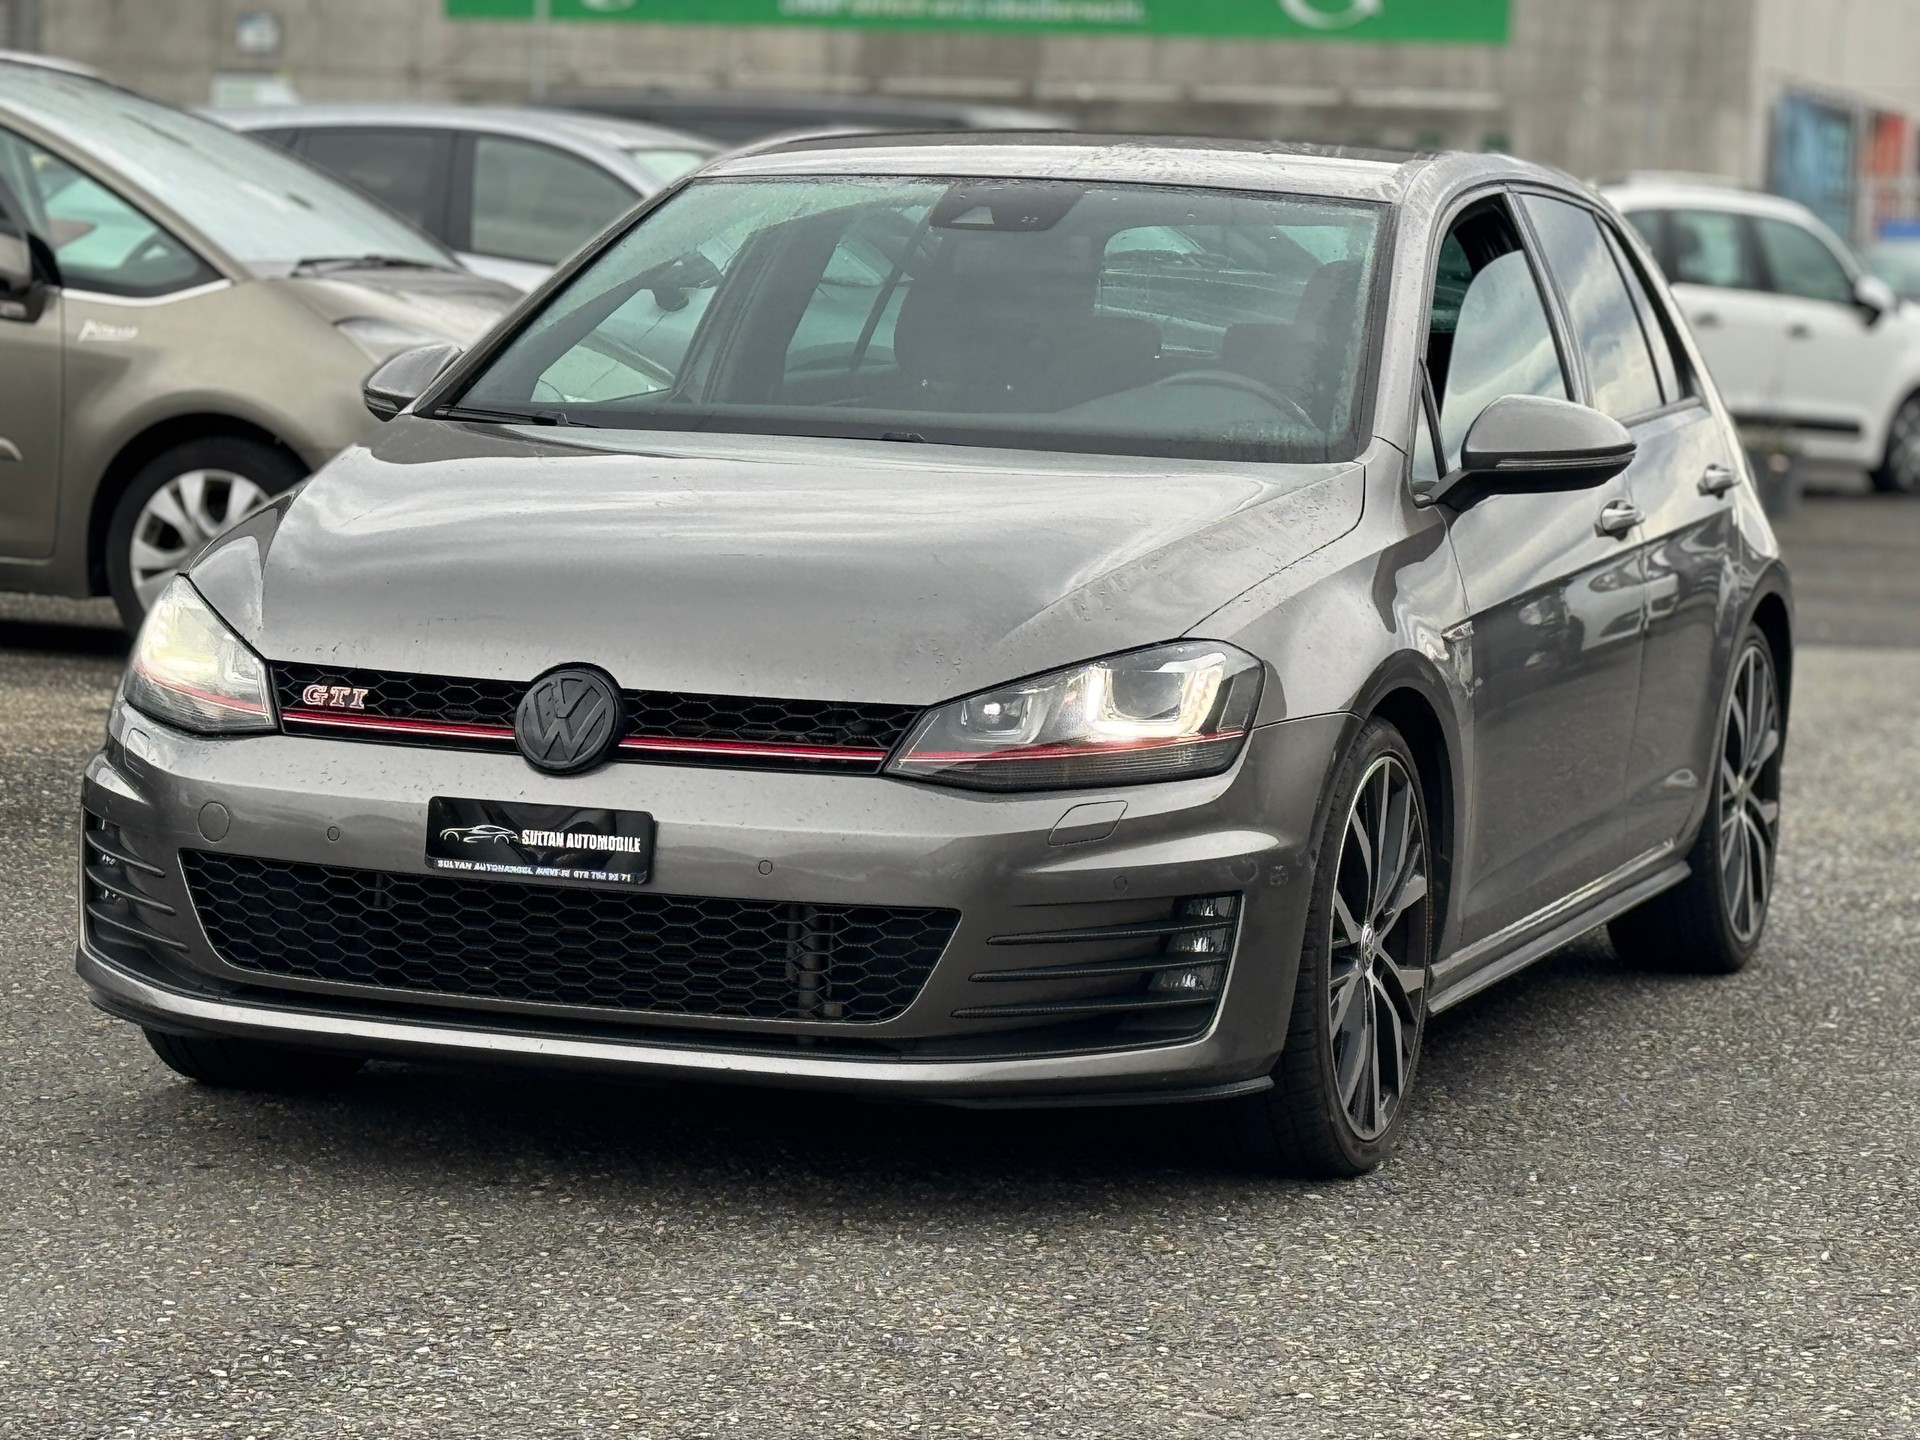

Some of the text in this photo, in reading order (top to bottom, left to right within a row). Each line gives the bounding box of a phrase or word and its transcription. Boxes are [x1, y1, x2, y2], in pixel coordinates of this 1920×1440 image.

[302, 684, 369, 709] GTI
[521, 829, 641, 853] SULTAN AUTOMOBILE
